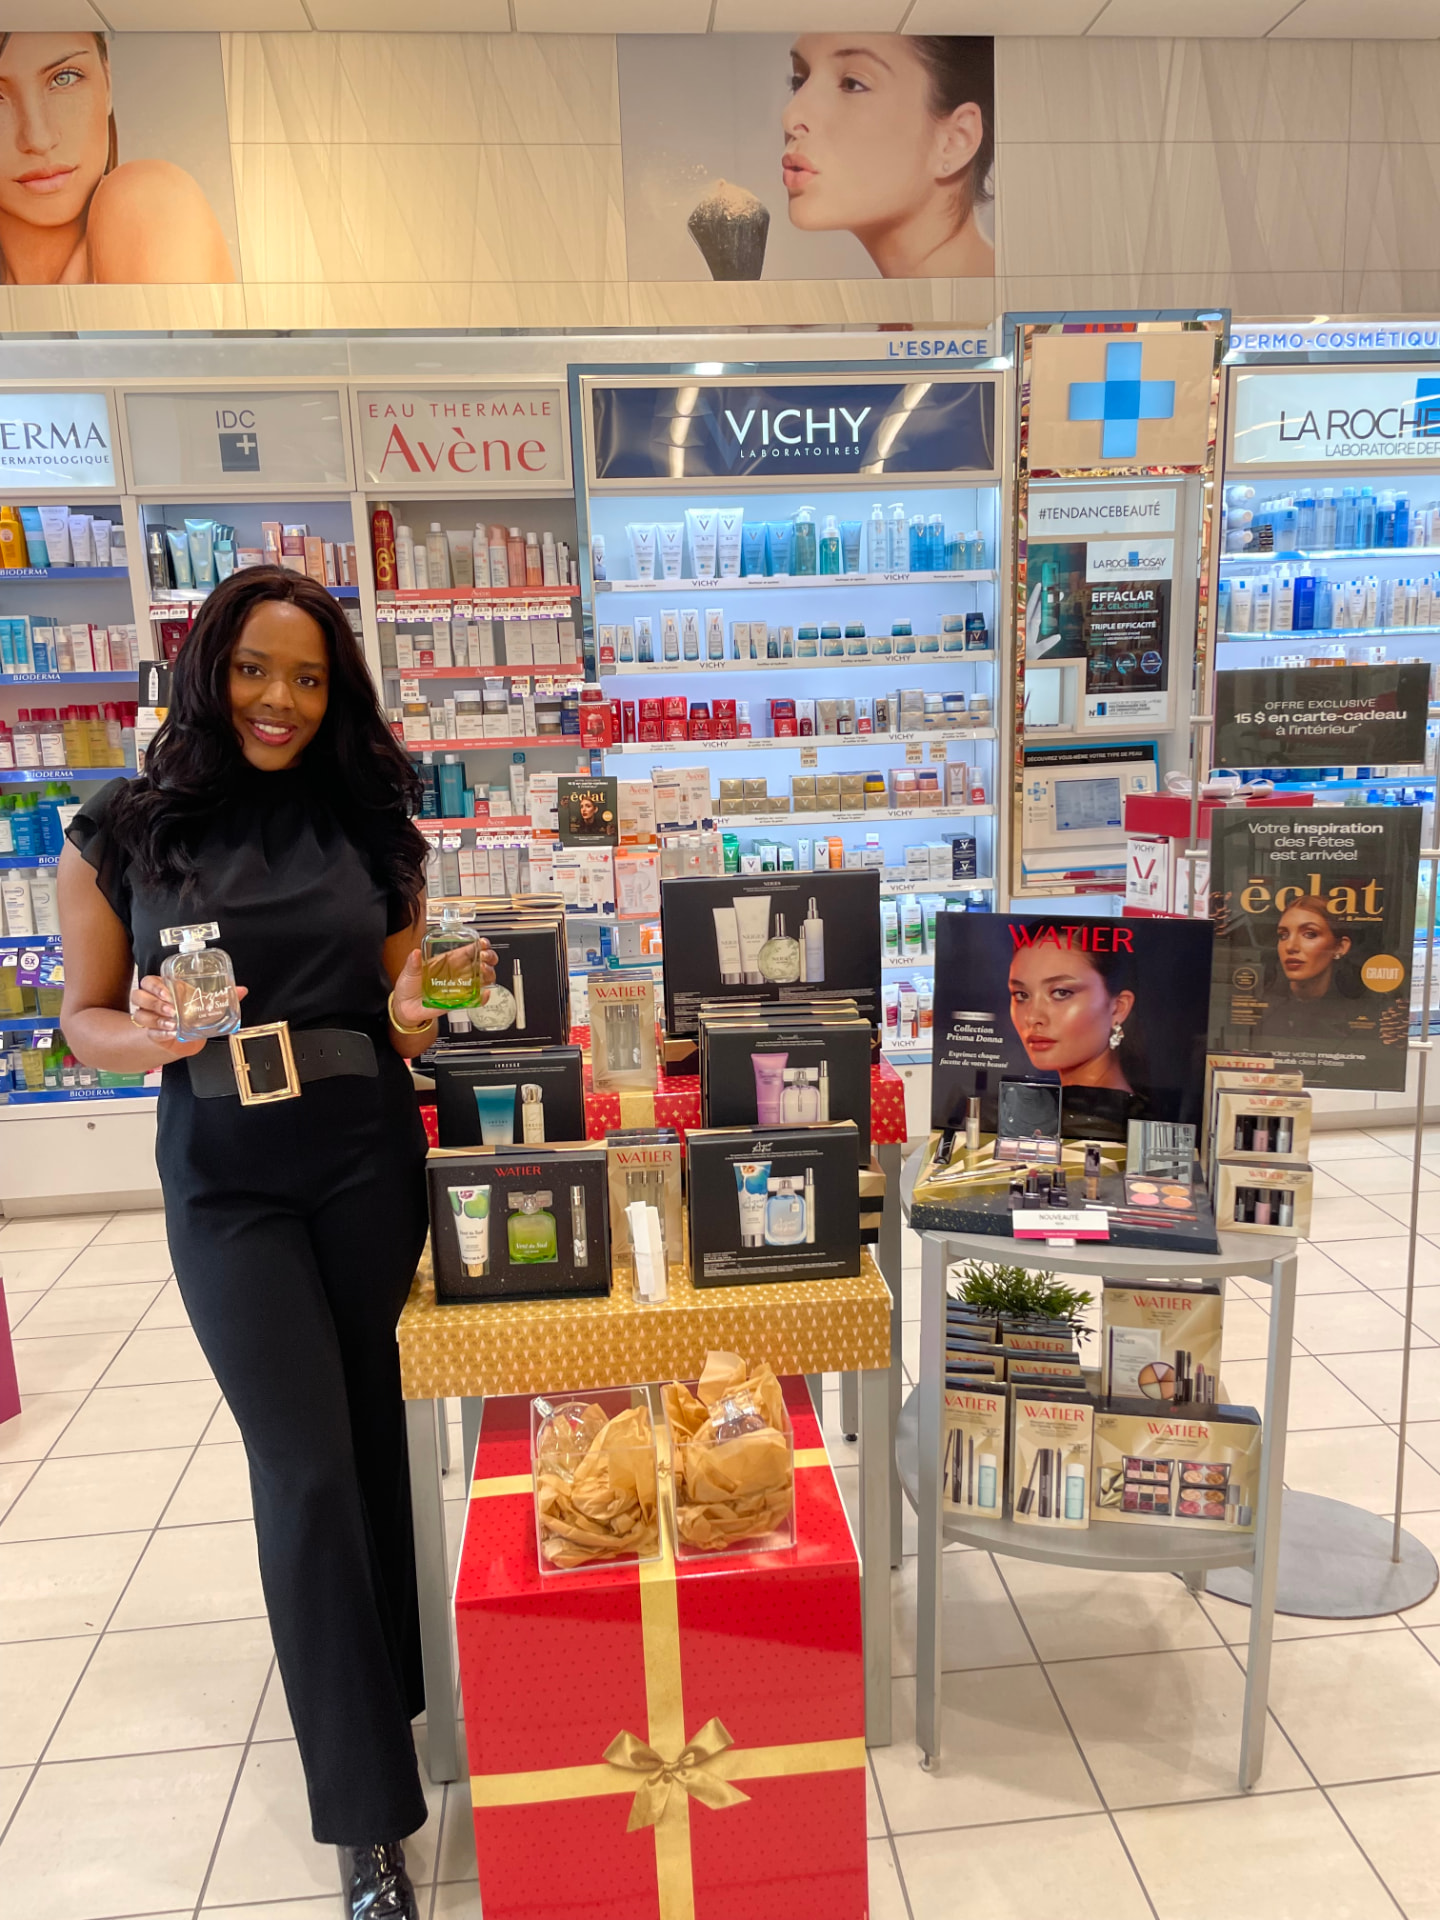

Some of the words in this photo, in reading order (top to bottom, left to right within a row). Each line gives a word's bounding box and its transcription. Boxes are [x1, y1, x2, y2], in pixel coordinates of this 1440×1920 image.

[1230, 328, 1440, 350] DERMO-COSMÉTIQU
[889, 340, 988, 357] L'ESPACE
[369, 404, 414, 418] EAU
[430, 402, 551, 418] THERMALE
[215, 410, 256, 429] IDC
[724, 407, 872, 445] VICHY
[1279, 410, 1320, 441] LA
[1327, 408, 1440, 440] ROCHE
[379, 423, 548, 474] Avène
[740, 446, 860, 458] LABORATOIRES
[1325, 442, 1415, 457] LABORATOIRE
[1038, 501, 1160, 520] #TENDANCEBEAUTÉ
[0, 569, 48, 577] BIODERMA
[1091, 590, 1154, 603] EFFACLAR
[13, 673, 61, 681] BIODERMA
[1264, 701, 1304, 710] OFFRE
[1308, 698, 1376, 709] EXCLUSIVE
[1234, 713, 1251, 724] 15
[1254, 711, 1266, 725] $
[1268, 714, 1289, 723] en
[1292, 709, 1407, 723] carte-cadeau
[1275, 726, 1286, 736] à
[1248, 823, 1291, 834] Votre
[1293, 822, 1383, 836] inspiration
[1274, 836, 1306, 847] des
[1308, 835, 1355, 847] Fêtes
[1270, 851, 1300, 861] est
[1300, 850, 1358, 861] arrivée!
[1008, 924, 1134, 952] WATIER
[889, 957, 915, 965] VICHY
[430, 977, 447, 986] Vent
[457, 977, 473, 986] Sud
[595, 985, 647, 998] WATIER
[953, 1024, 994, 1035] Collection
[946, 1033, 975, 1043] Prisma
[975, 1034, 1004, 1044] Donna
[70, 1089, 115, 1097] BIODERMA
[616, 1150, 672, 1165] WATIER
[495, 1166, 542, 1177] WATIER
[1039, 1212, 1080, 1221] NOUVEAUTÉ
[1133, 1295, 1193, 1311] WATIER
[1024, 1405, 1085, 1422] WATIER
[1147, 1422, 1209, 1439] WATIER
